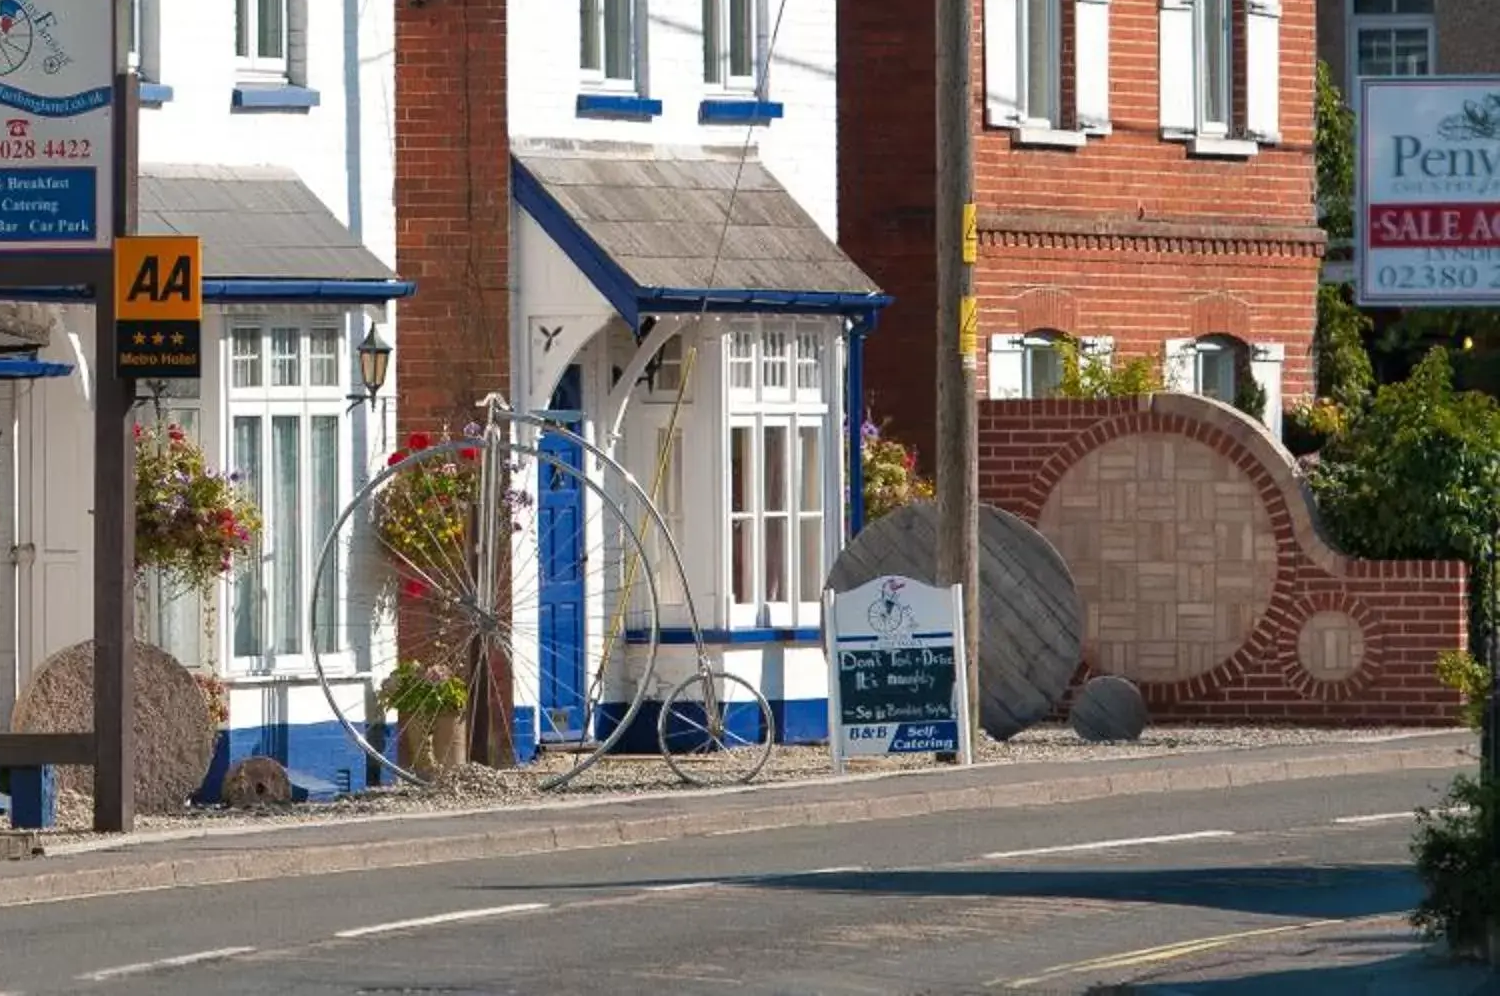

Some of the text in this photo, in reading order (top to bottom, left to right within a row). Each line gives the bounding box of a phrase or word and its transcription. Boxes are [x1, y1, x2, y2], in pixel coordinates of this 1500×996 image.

[43, 138, 92, 159] 4422
[7, 177, 70, 190] Breakfast
[1, 198, 60, 214] Catering
[29, 219, 55, 232] Car
[58, 219, 90, 232] Park
[127, 255, 191, 302] AA
[1378, 265, 1478, 288] 02380
[161, 351, 197, 365] Hotel
[841, 651, 882, 671] Don't
[894, 738, 953, 750] Catering
